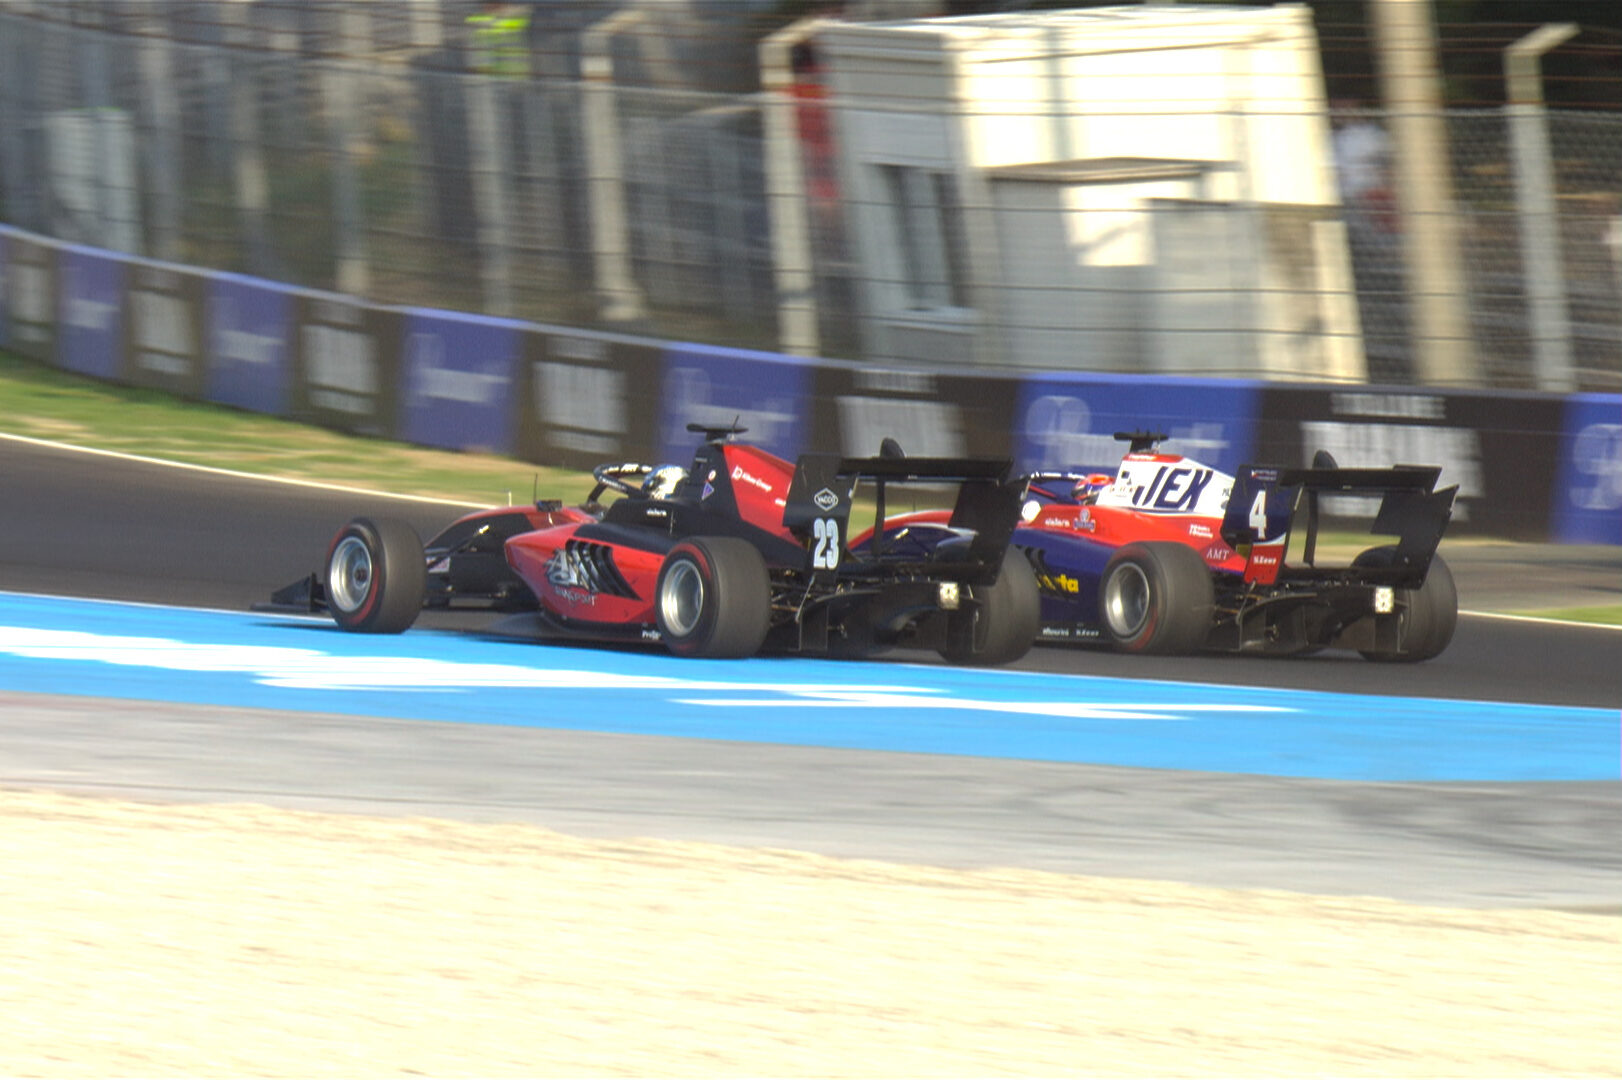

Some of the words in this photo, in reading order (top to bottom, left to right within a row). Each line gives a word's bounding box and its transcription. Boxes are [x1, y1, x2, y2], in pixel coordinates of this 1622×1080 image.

[1248, 489, 1267, 540] 4
[812, 517, 840, 571] 23
[1206, 547, 1230, 561] AMT
